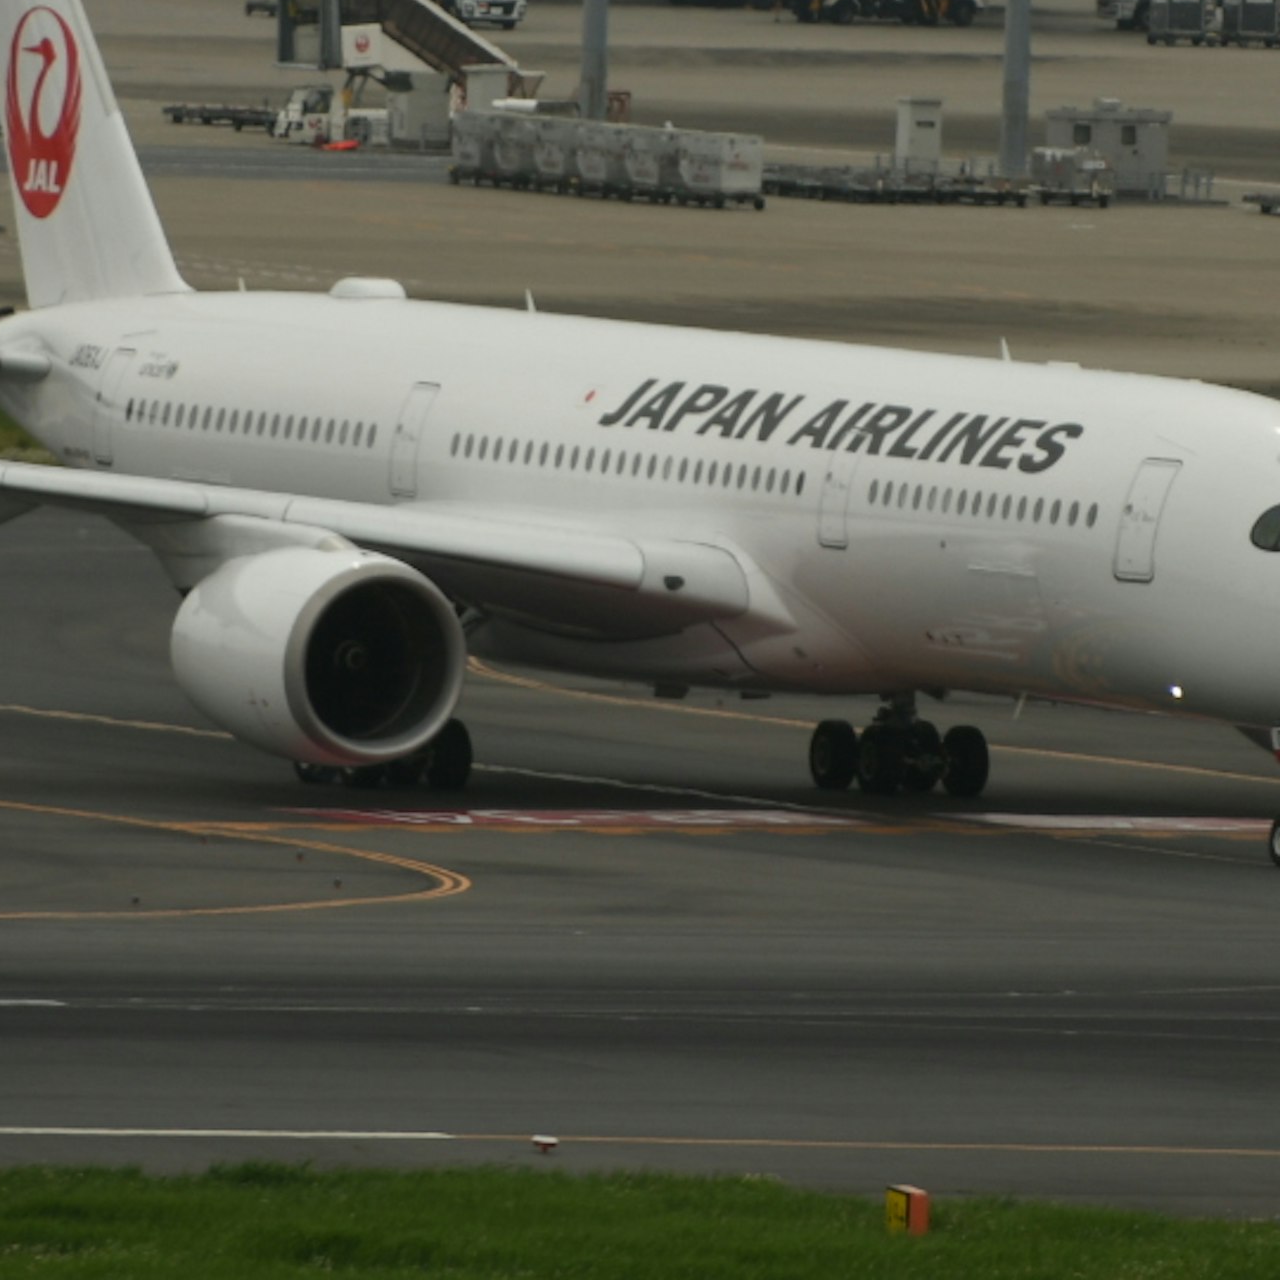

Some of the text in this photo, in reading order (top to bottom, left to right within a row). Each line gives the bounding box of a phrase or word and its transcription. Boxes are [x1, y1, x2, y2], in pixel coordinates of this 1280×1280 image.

[23, 158, 60, 193] JAL
[598, 377, 1084, 474] JAPAN AIRLINES
